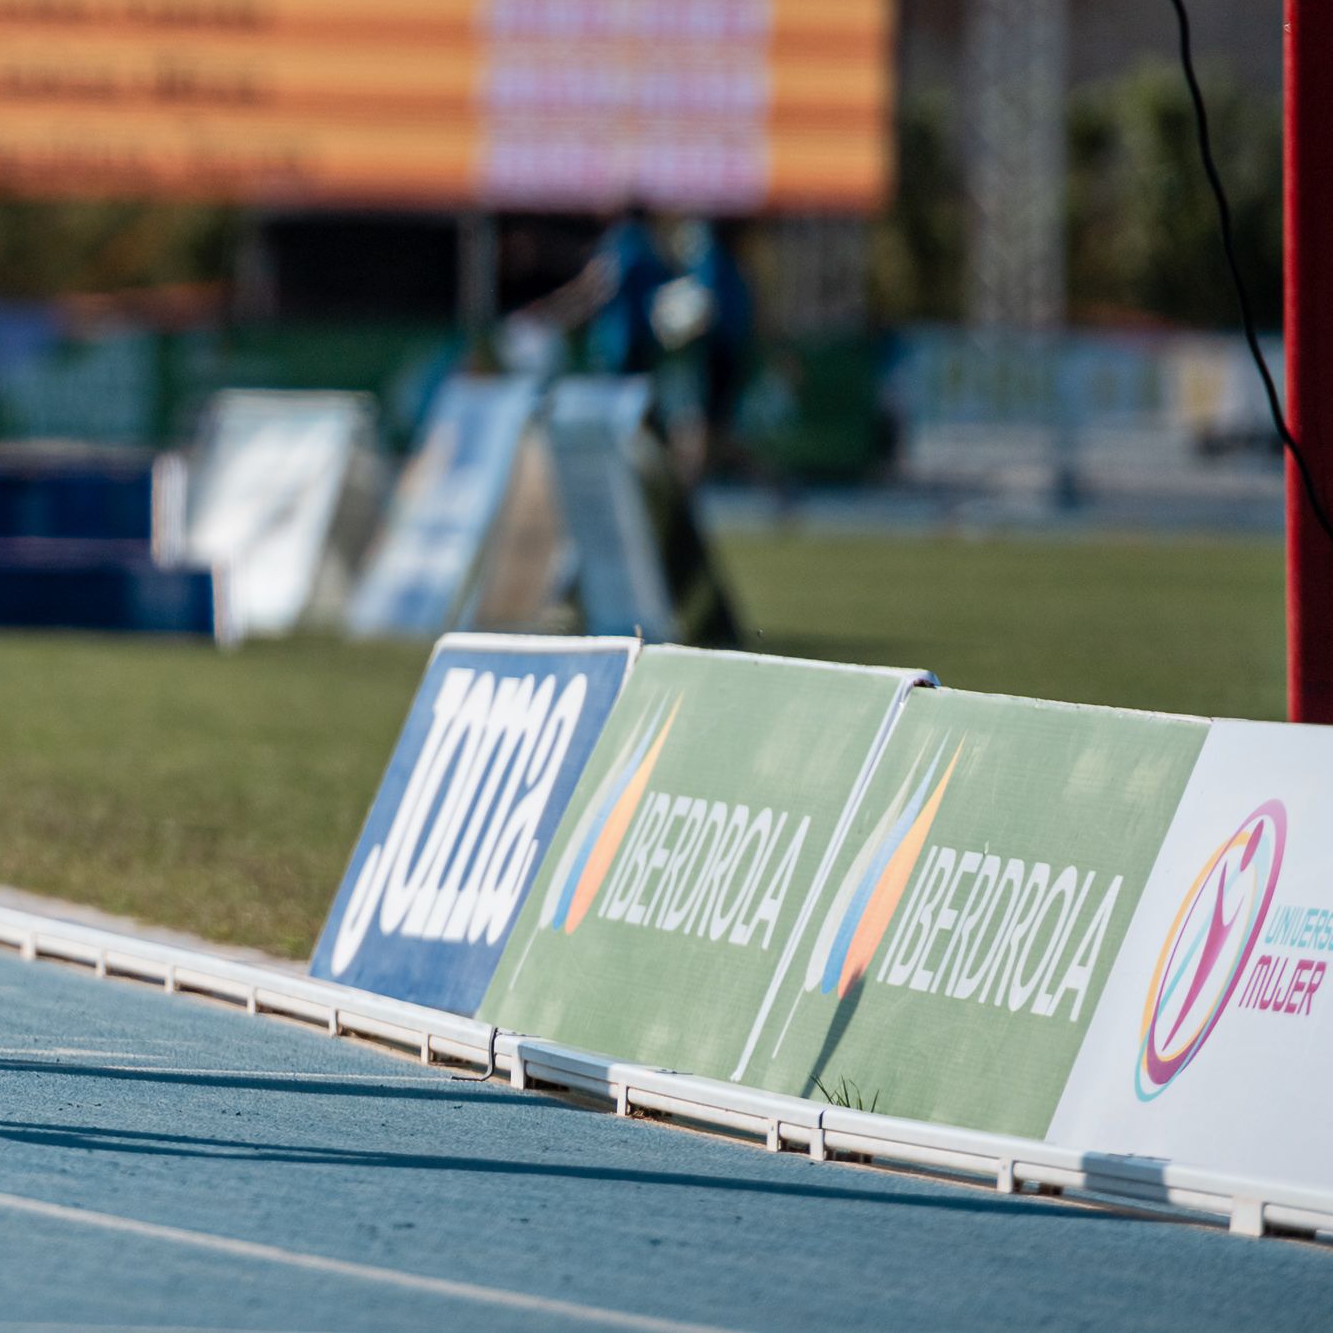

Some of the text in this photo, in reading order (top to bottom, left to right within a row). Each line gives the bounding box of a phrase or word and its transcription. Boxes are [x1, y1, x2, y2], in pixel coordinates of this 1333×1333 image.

[598, 791, 811, 951] IBERDROLA
[876, 845, 1124, 1023] IBERDROLA
[1264, 906, 1333, 952] UNIVERS
[1237, 954, 1328, 1017] MUJER
